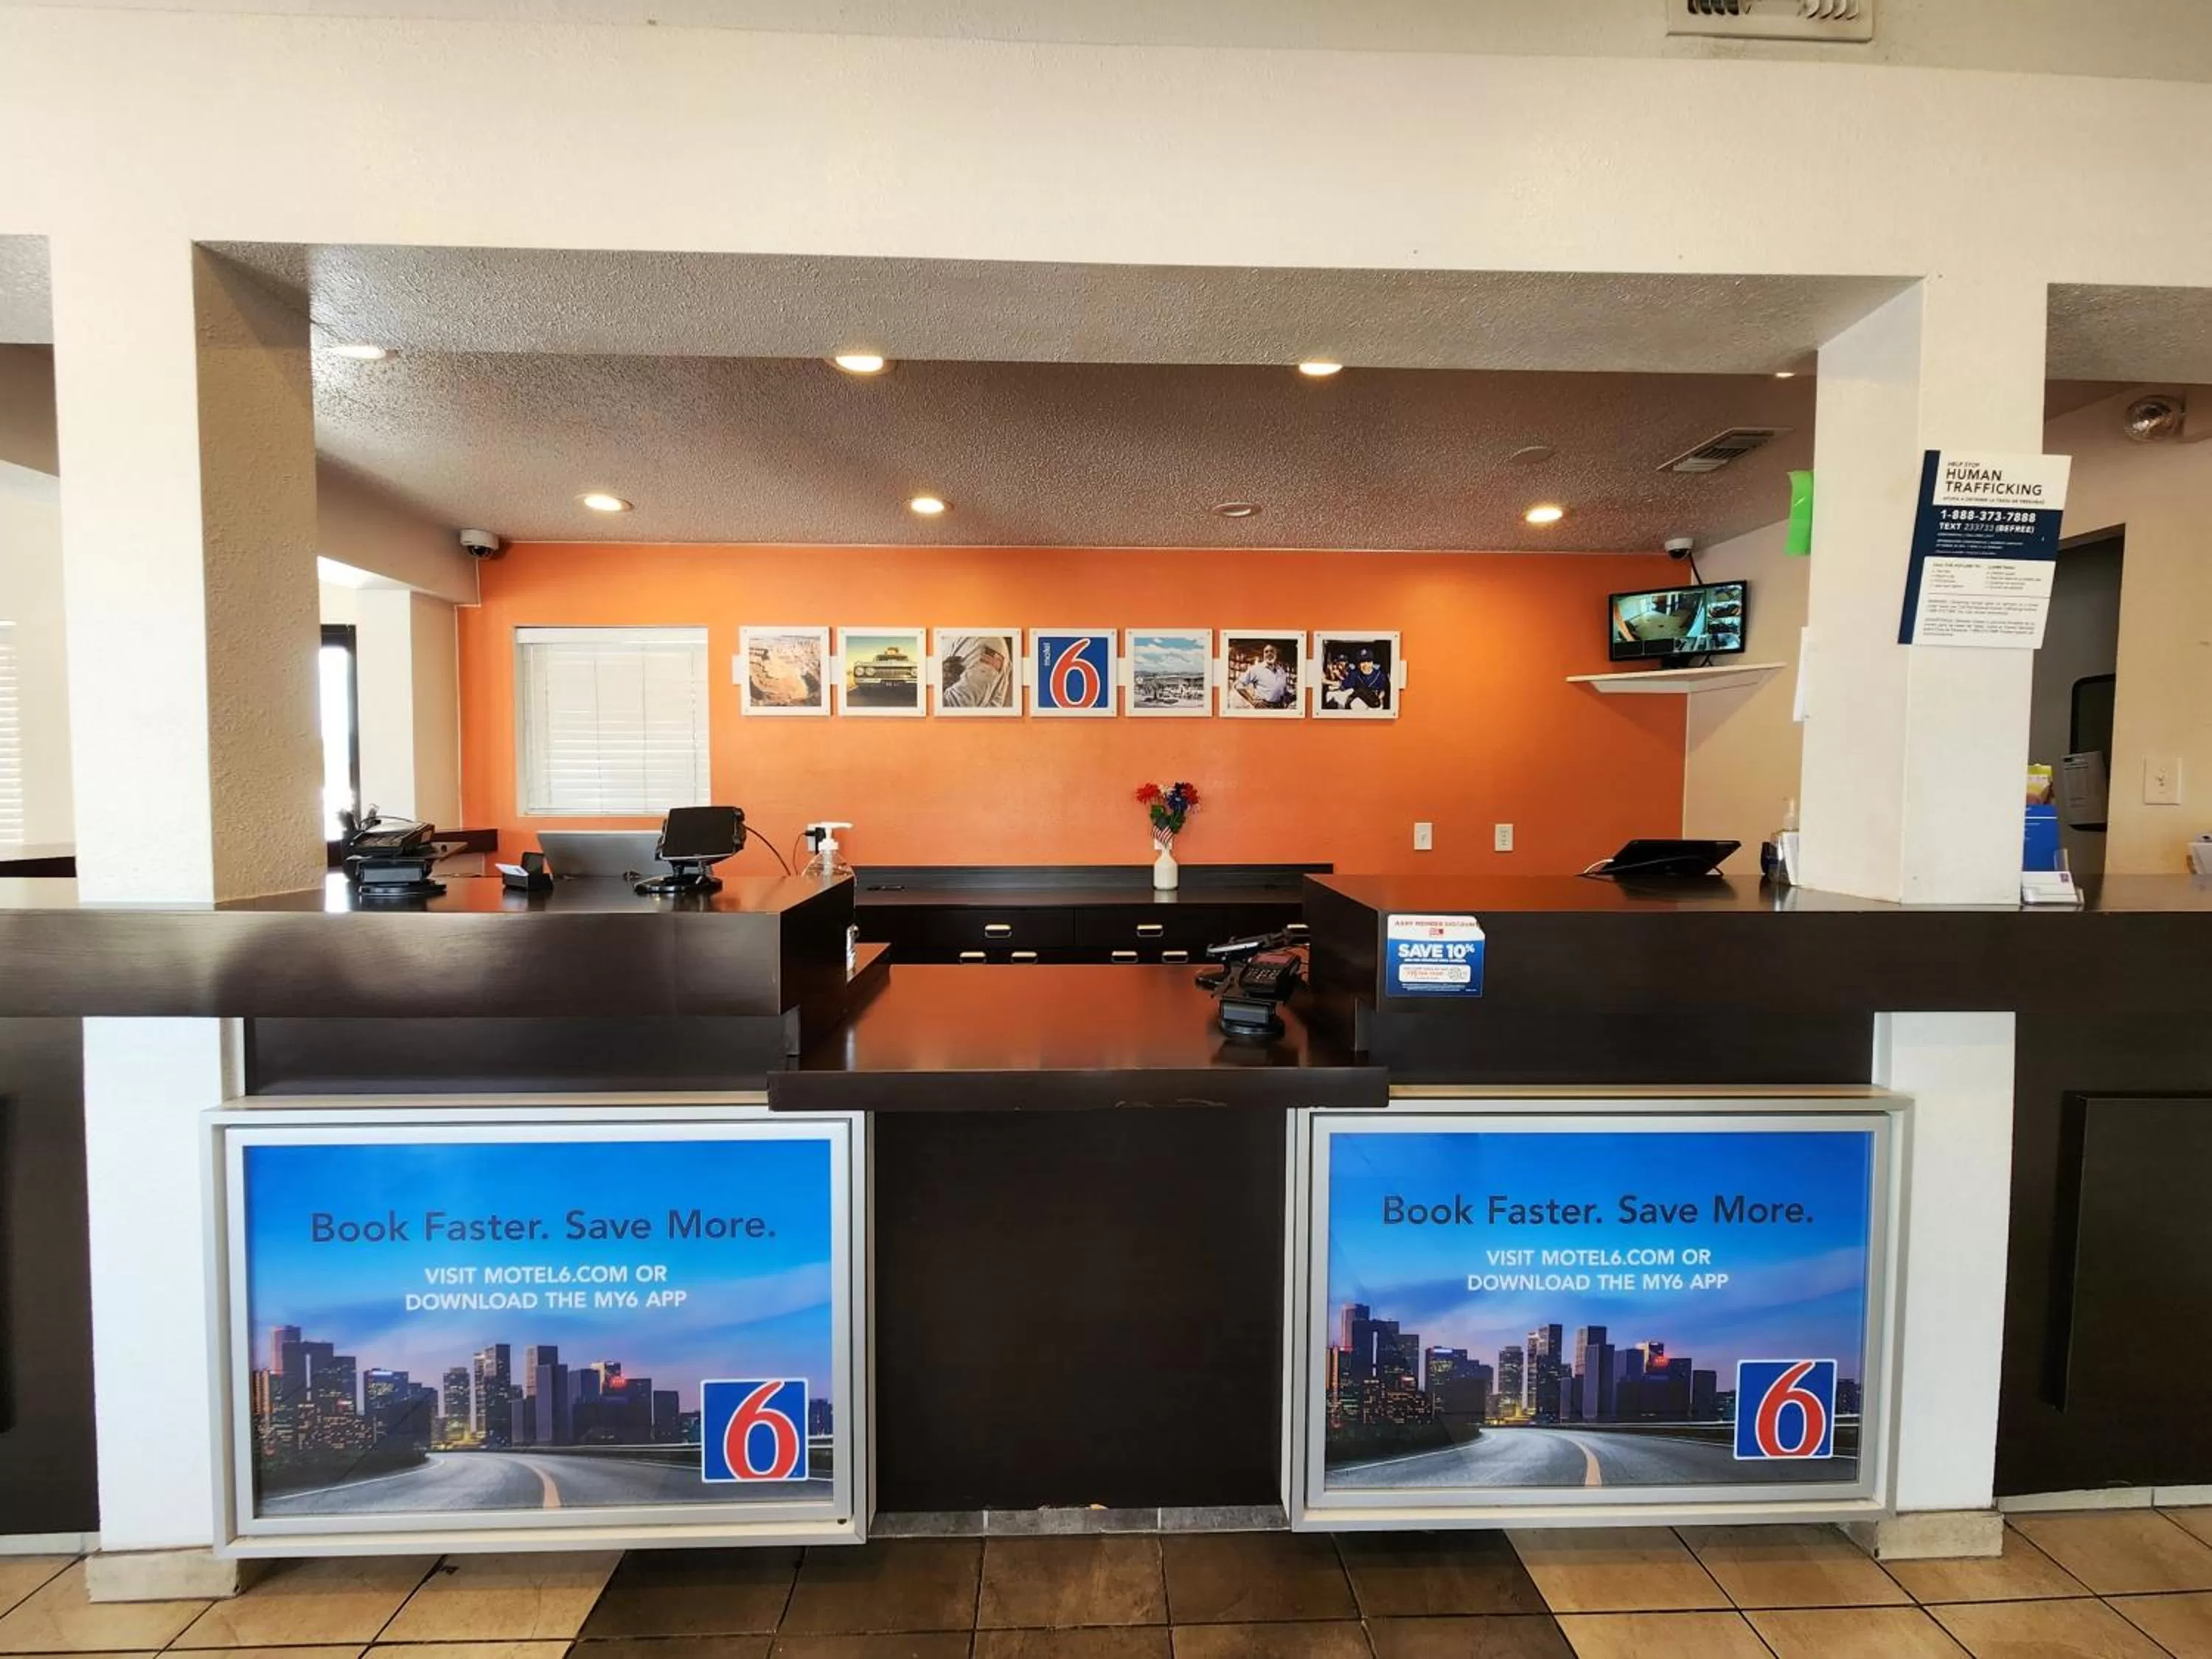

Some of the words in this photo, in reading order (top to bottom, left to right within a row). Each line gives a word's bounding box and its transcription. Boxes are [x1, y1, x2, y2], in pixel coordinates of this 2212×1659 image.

[1945, 468, 2003, 481] HUMAN
[1945, 481, 2043, 496] TRAFFICKING
[1940, 509, 2037, 523] 1-888-373-7888
[1938, 522, 1962, 531] TEXT
[1049, 638, 1100, 709] 6
[1398, 943, 1444, 959] SAVE
[1446, 943, 1475, 959] 10%
[1382, 1194, 1475, 1225] Book
[1487, 1194, 1603, 1225] Faster.
[1618, 1194, 1699, 1225] Save
[1713, 1194, 1814, 1225] More.
[311, 1209, 410, 1242] Book
[423, 1211, 549, 1242] Faster.
[565, 1209, 653, 1240] Save
[667, 1208, 776, 1240] More.
[1486, 1250, 1535, 1267] VISIT
[1541, 1248, 1674, 1266] MOTEL6.COM
[1682, 1248, 1711, 1265] OR
[424, 1267, 478, 1284] VISIT
[484, 1265, 628, 1284] MOTEL6.COM
[635, 1265, 668, 1283] OR
[1467, 1273, 1590, 1292] DOWNLOAD
[1597, 1273, 1636, 1292] THE
[1642, 1273, 1684, 1290] MY6
[1688, 1273, 1730, 1290] APP
[405, 1291, 538, 1311] DOWNLOAD
[544, 1290, 587, 1310] THE
[594, 1290, 639, 1309] MY6
[644, 1290, 688, 1308] APP
[1755, 1358, 1826, 1459] 6
[723, 1378, 800, 1482] 6
